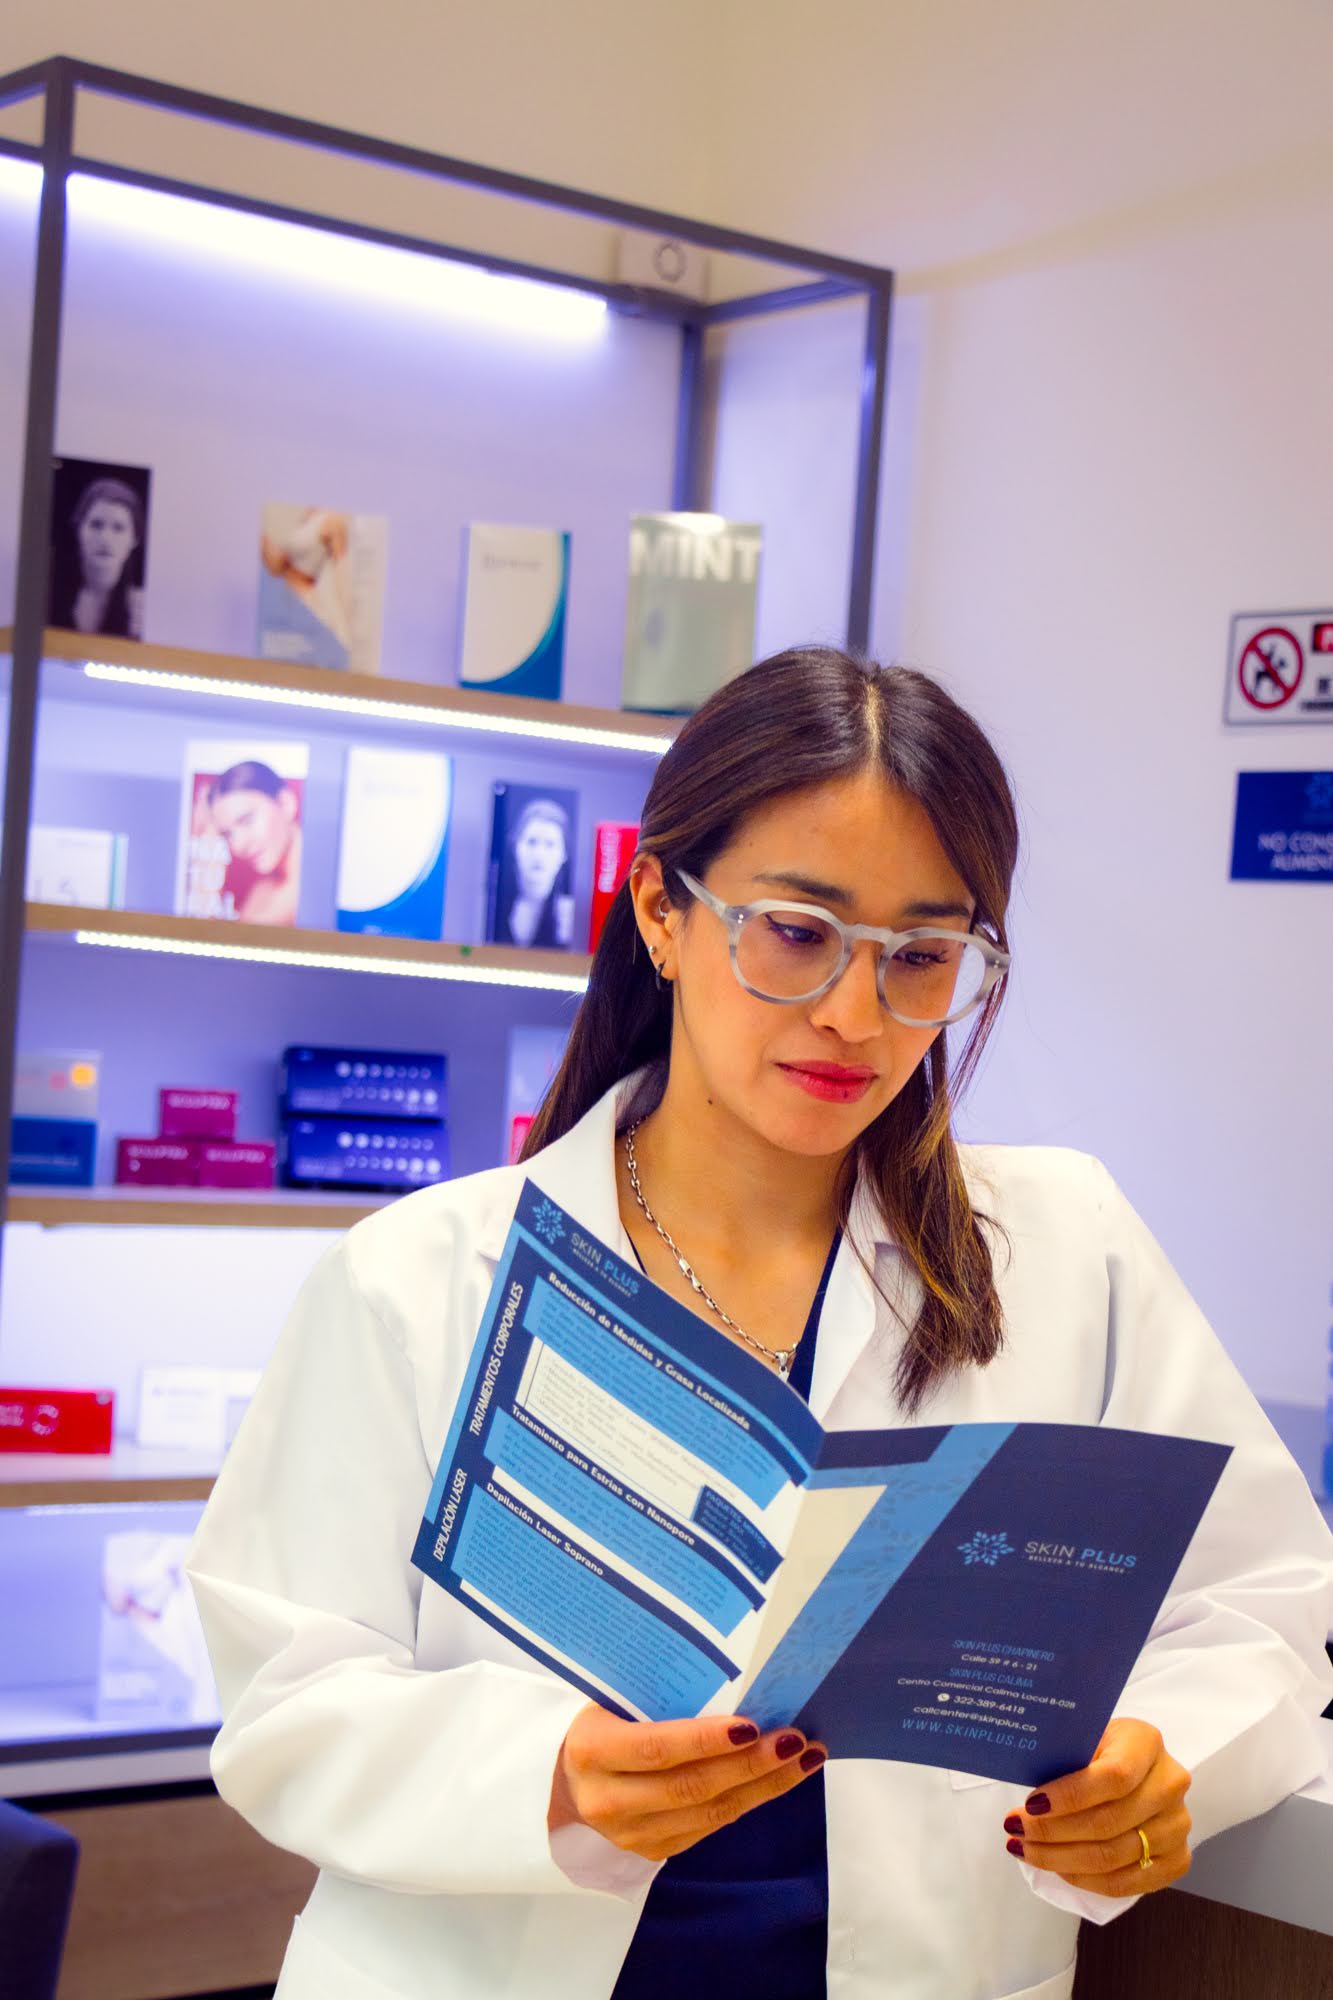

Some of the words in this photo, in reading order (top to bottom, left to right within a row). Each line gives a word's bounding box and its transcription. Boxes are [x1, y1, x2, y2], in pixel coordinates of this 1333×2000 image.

[571, 1232, 602, 1265] SKIN
[604, 1259, 640, 1294] PLUS
[469, 1354, 502, 1436] TRATAMIENTOS
[493, 1281, 524, 1357] CORPORALES
[548, 1271, 596, 1317] Reducción
[598, 1314, 611, 1328] de
[612, 1324, 653, 1361] Medidas
[655, 1355, 663, 1368] y
[665, 1363, 694, 1390] Grasa
[696, 1385, 750, 1430] Localizada
[512, 1404, 564, 1452] Tratamiento
[566, 1450, 589, 1472] para
[591, 1466, 623, 1496] Estrias
[625, 1493, 645, 1511] con
[647, 1506, 695, 1546] Nanopore
[433, 1500, 459, 1562] DEPILACIÓN
[450, 1468, 468, 1502] LASER
[486, 1482, 533, 1525] Depilación
[535, 1521, 562, 1545] Laser
[563, 1542, 603, 1576] Soprano
[1024, 1541, 1076, 1558] SKIN
[1081, 1548, 1137, 1568] PLUS
[897, 1677, 931, 1686] Centro
[932, 1679, 984, 1693] Comercial
[985, 1685, 1019, 1699] Calima
[1021, 1691, 1049, 1704] Local
[961, 1653, 987, 1664] Calle
[1025, 1662, 1037, 1672] 21
[901, 1717, 1038, 1751] WWW.SKINPLUS.CO
[913, 1705, 1037, 1733] callcenter@skinplus.co
